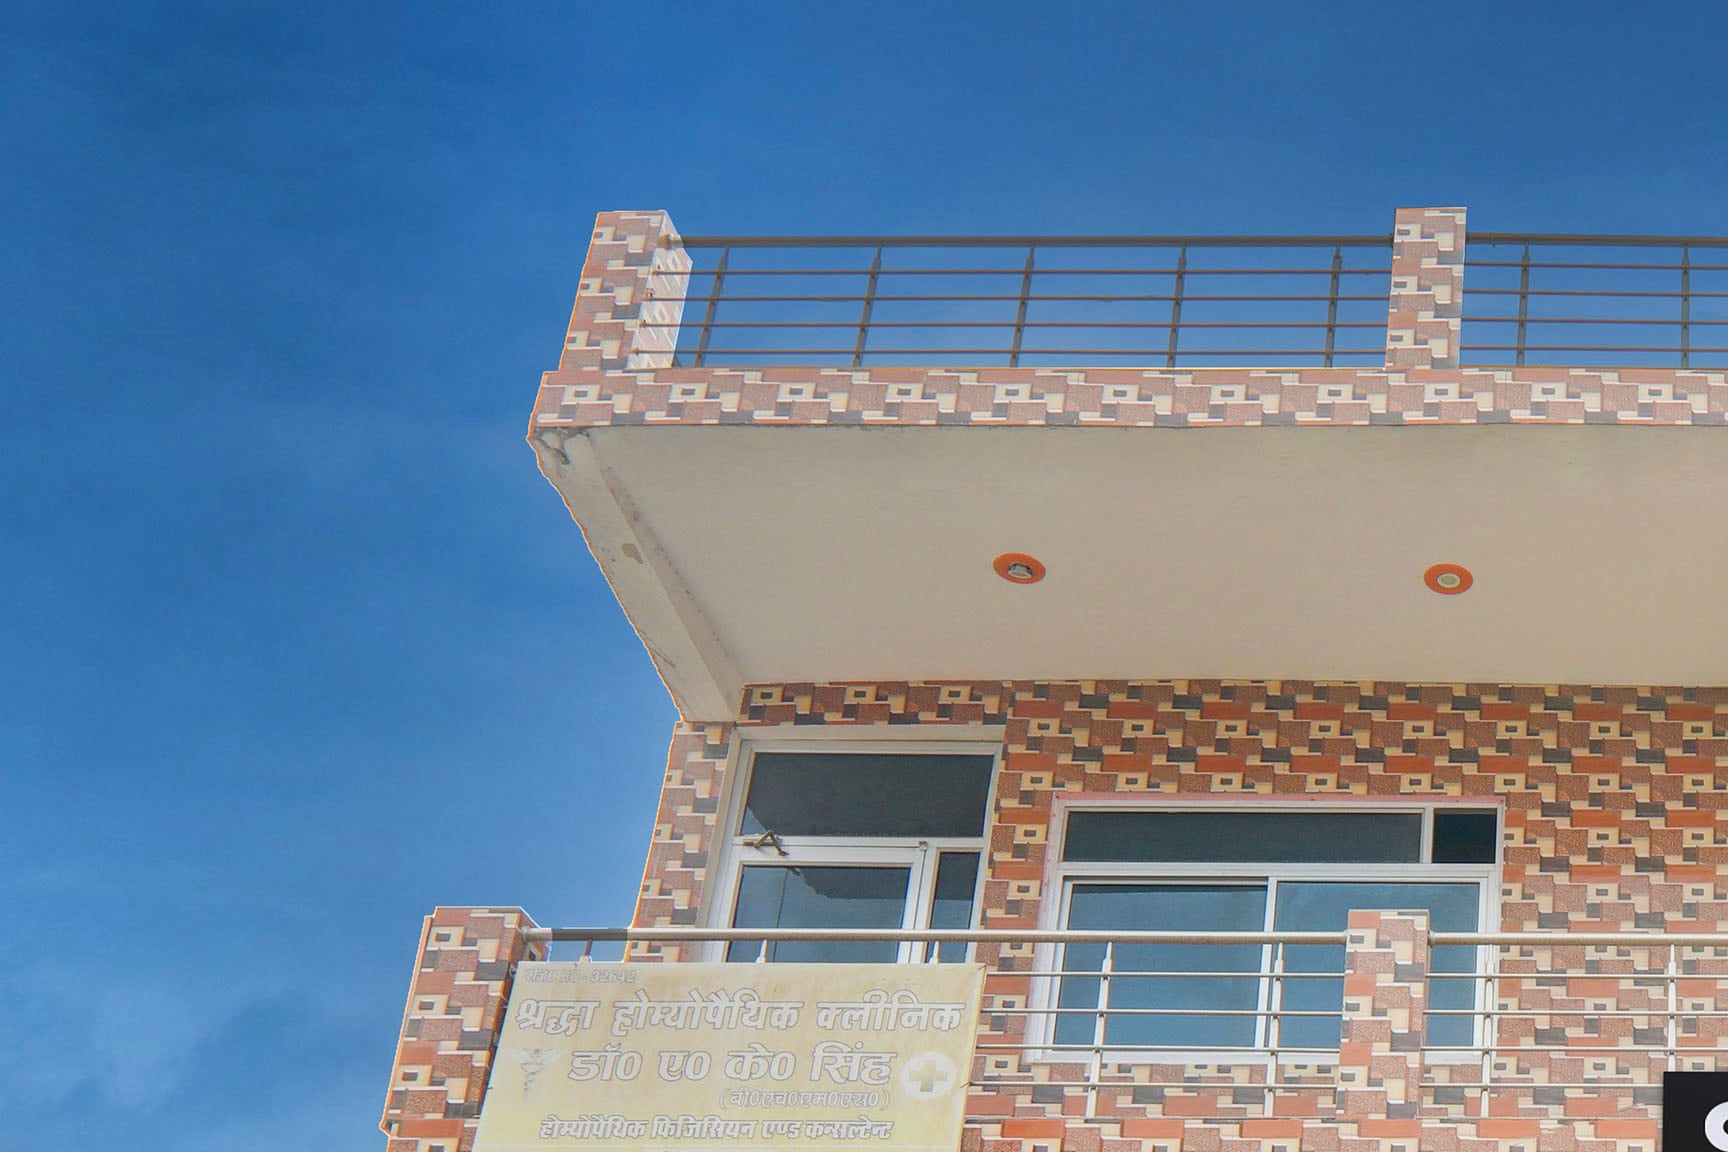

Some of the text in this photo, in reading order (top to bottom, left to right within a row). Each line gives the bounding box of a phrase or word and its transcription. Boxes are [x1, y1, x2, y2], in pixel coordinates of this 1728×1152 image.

[515, 987, 966, 1037] श्रद्धा होम्योपैथिक क्लीनिक
[809, 1041, 898, 1085] सिंह
[539, 1113, 648, 1139] होम्योपैथिक
[651, 1114, 758, 1139] फिजिसियन
[761, 1119, 803, 1139] एण्ड
